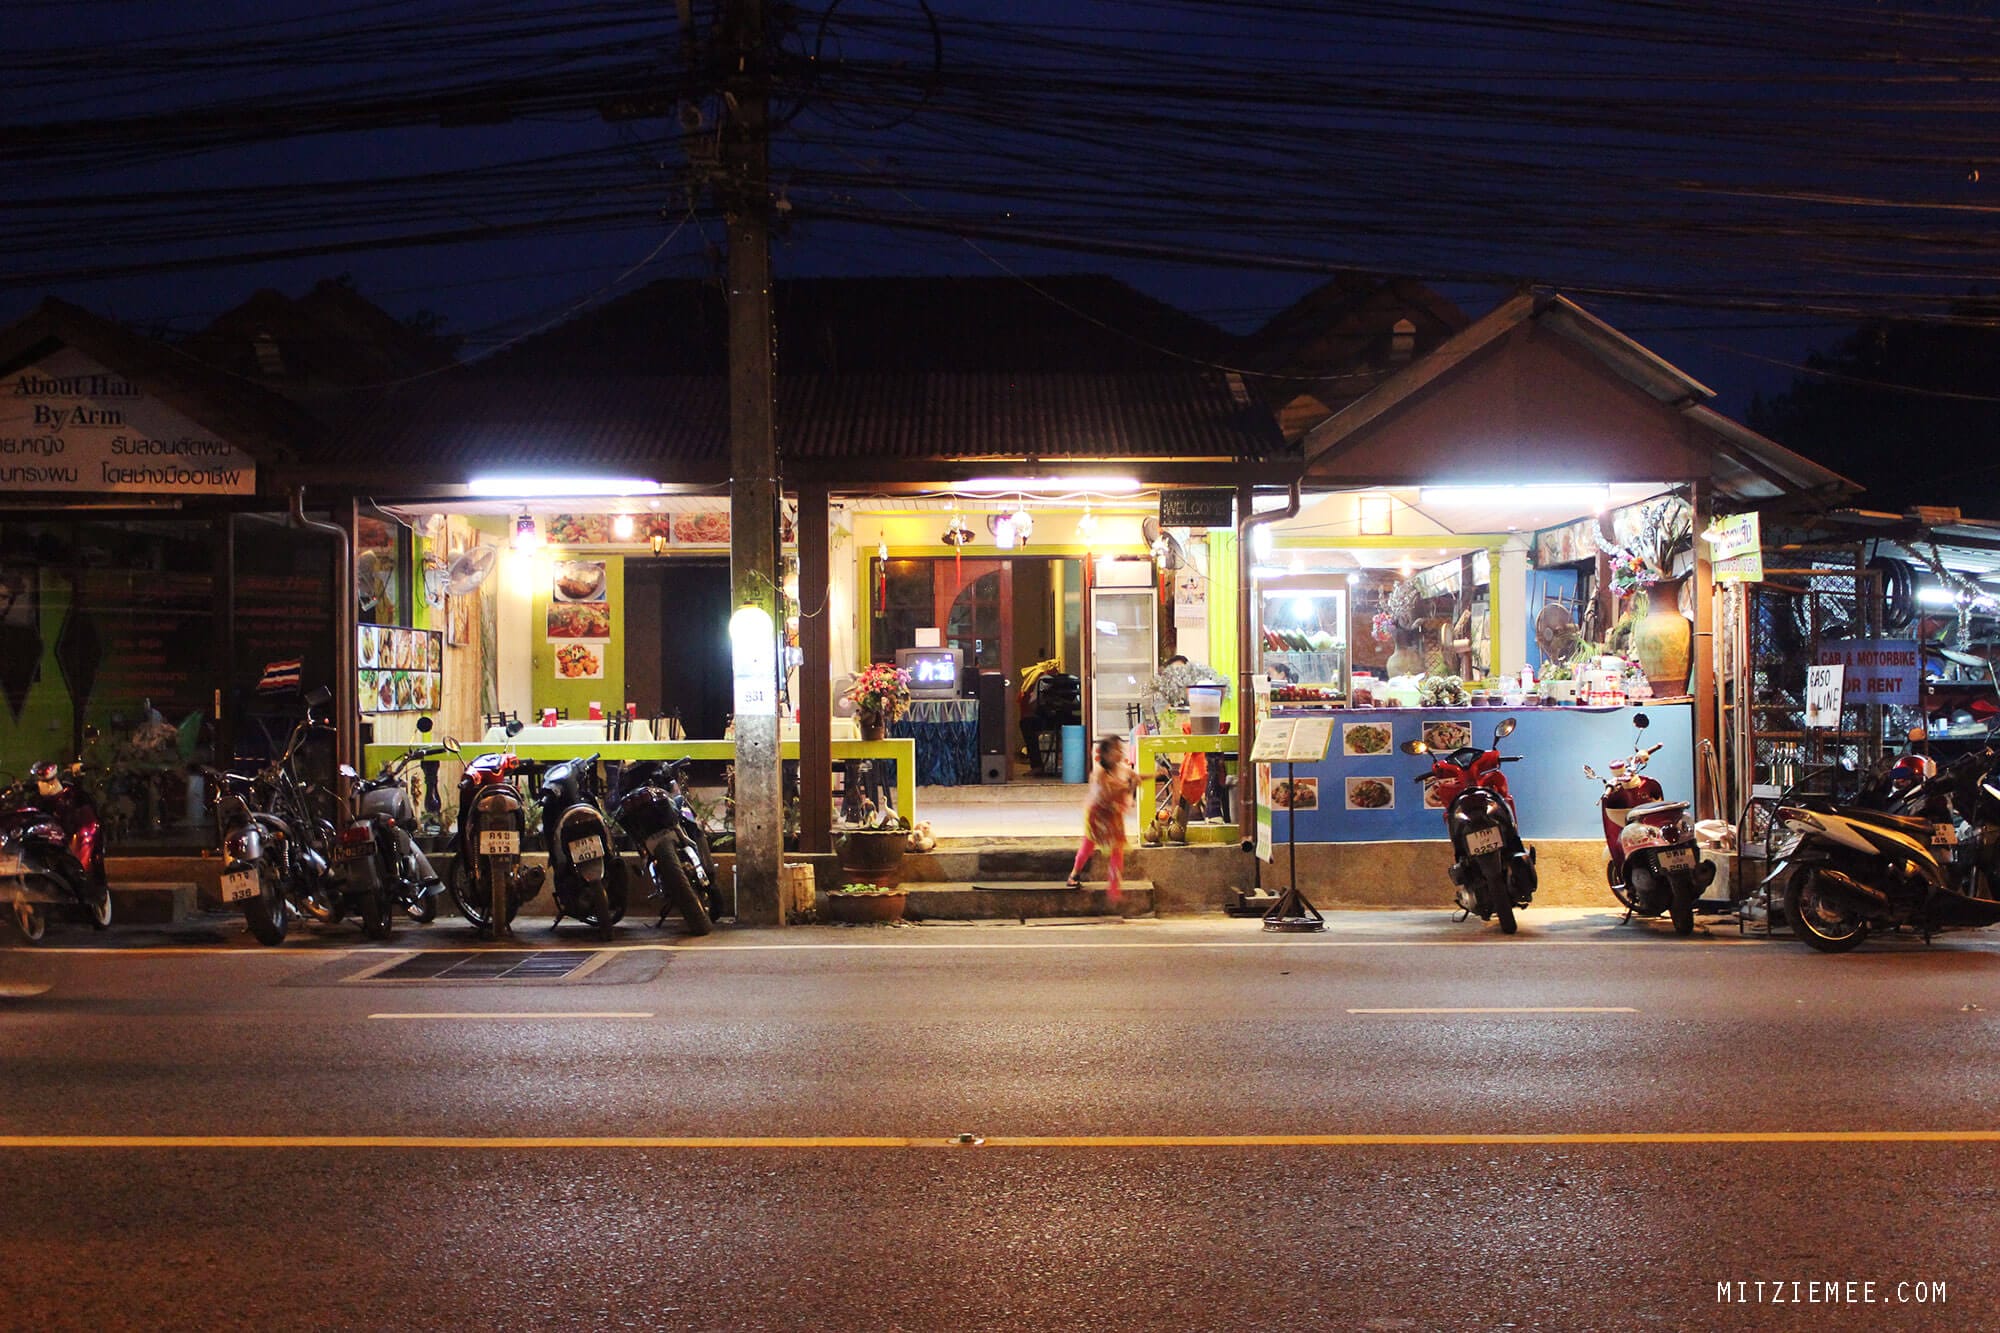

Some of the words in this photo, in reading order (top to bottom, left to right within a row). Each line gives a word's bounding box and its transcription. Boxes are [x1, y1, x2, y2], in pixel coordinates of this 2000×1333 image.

[14, 375, 82, 396] About
[34, 404, 64, 434] By
[69, 405, 122, 425] Arm
[1821, 651, 1842, 666] CAR
[1857, 651, 1915, 666] MOTORBIKE
[1844, 678, 1861, 693] OR
[1867, 678, 1903, 693] RENT
[1817, 688, 1839, 712] LINE
